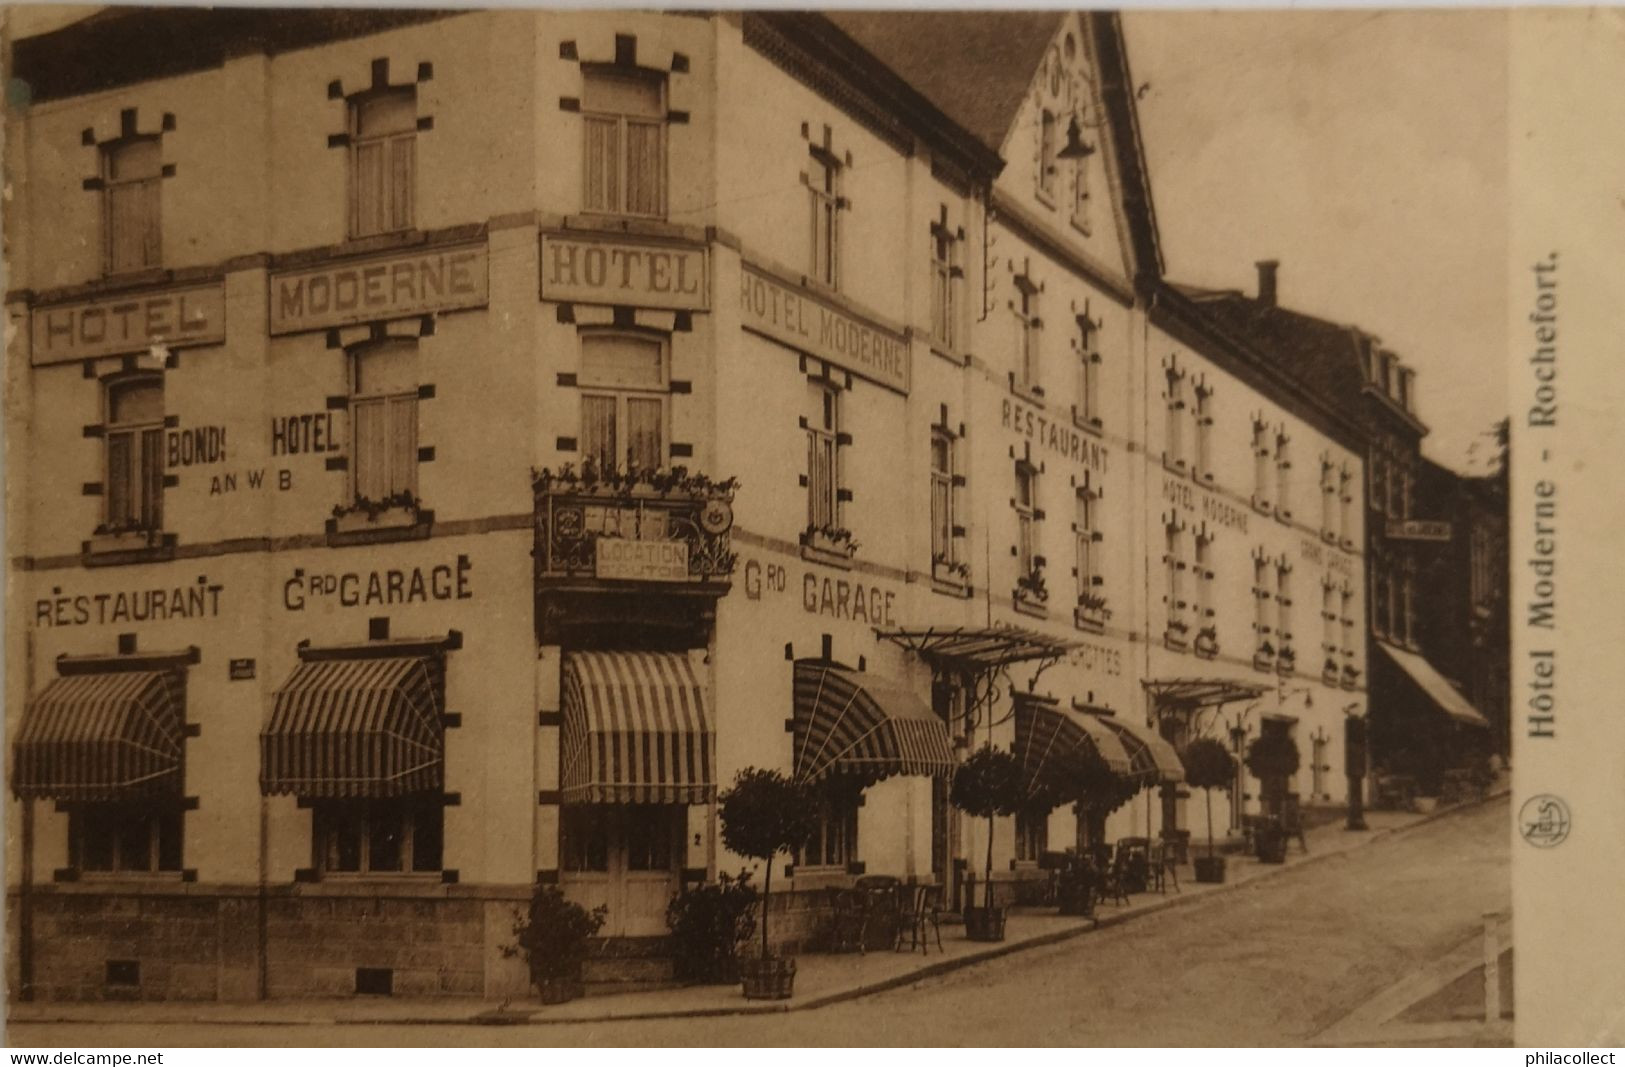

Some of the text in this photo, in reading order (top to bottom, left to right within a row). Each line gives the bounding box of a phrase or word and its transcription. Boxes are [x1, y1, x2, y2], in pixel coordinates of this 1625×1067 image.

[279, 255, 475, 321] MODERNE
[550, 245, 697, 294] HOTEL
[46, 298, 207, 349] HOTEL
[740, 272, 903, 379] HOTEL MODERNE
[272, 413, 340, 456] HOTEL
[1002, 398, 1110, 476] RESTAURANT
[1162, 478, 1248, 536] HOTEL MODERNE
[599, 542, 685, 565] LOCATION
[36, 584, 225, 628] RESTAURANT
[340, 566, 473, 607] GARAGE
[803, 573, 896, 627] GARAGE
